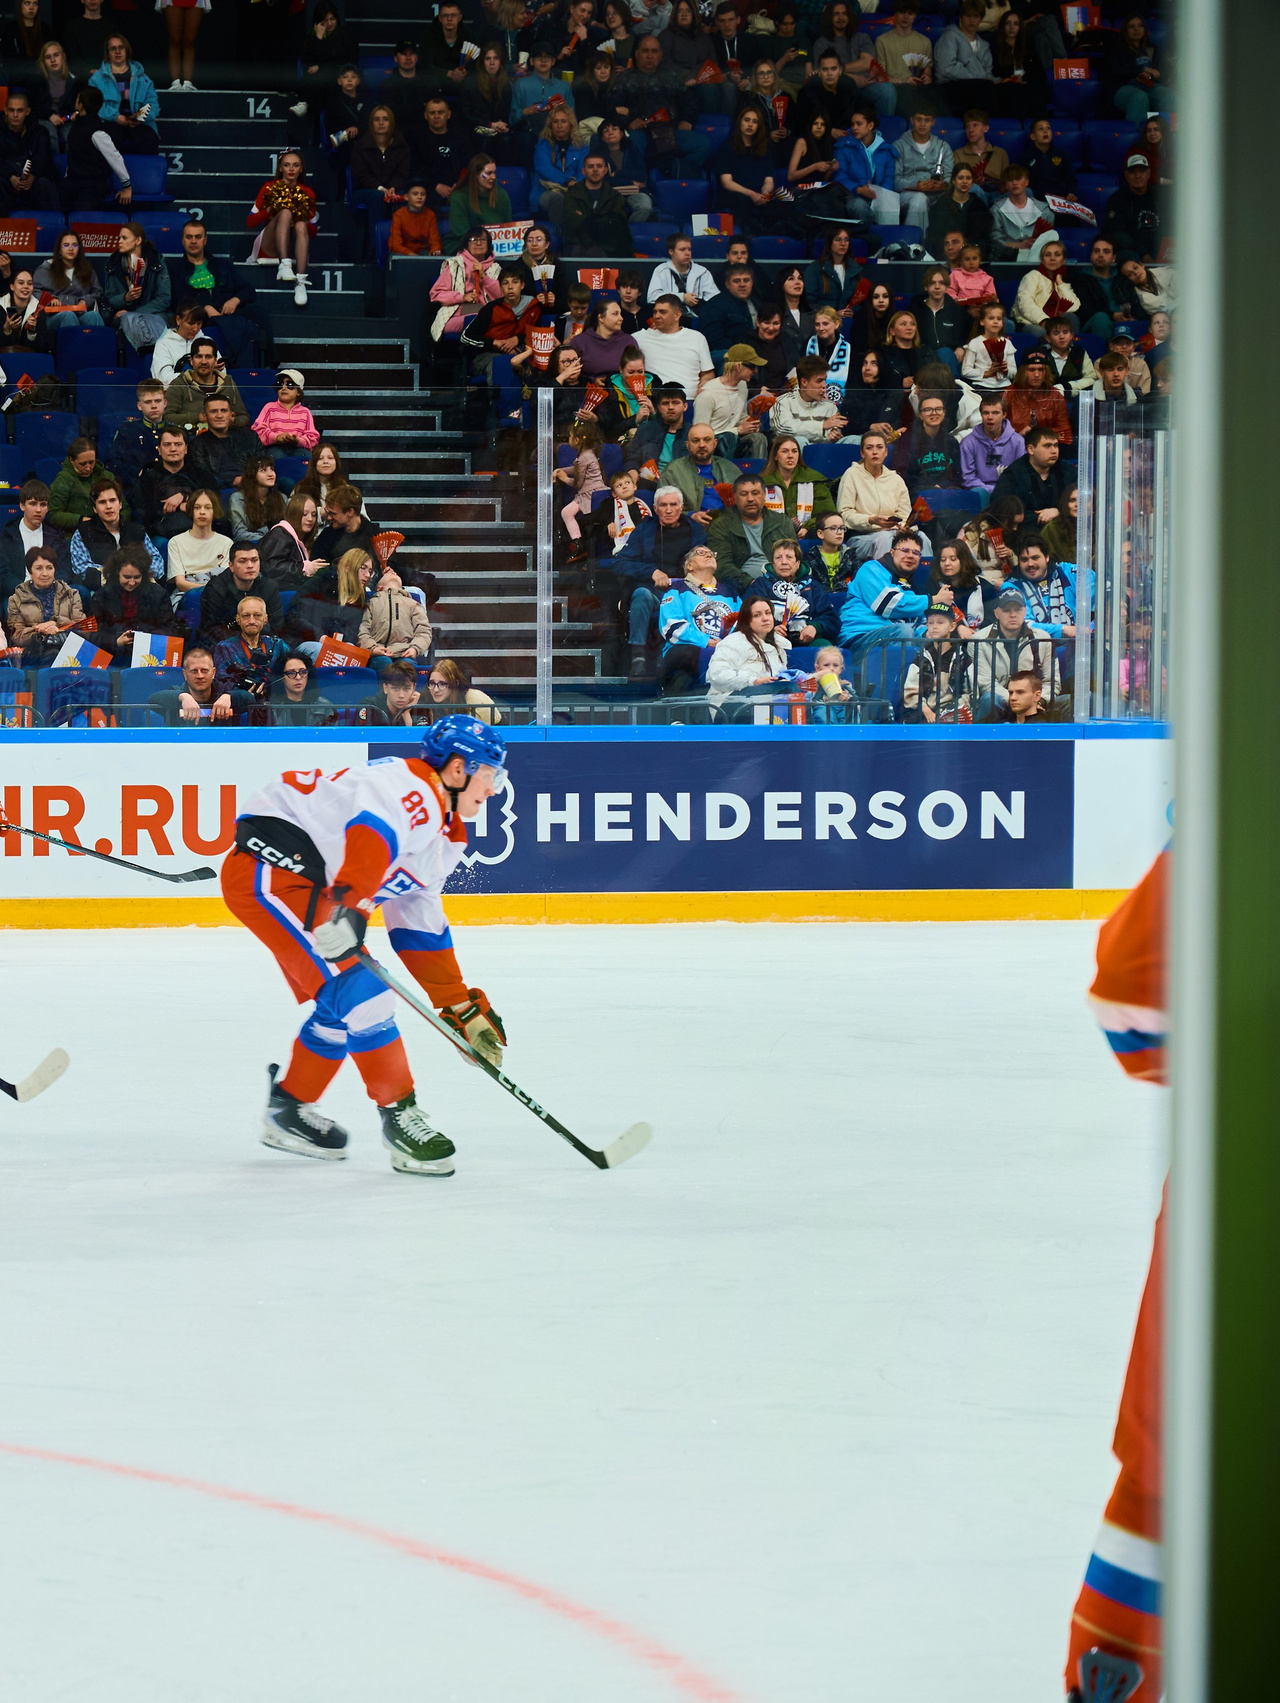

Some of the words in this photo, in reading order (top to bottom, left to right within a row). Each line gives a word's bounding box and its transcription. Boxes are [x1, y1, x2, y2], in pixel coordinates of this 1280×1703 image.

[247, 97, 271, 118] 14
[160, 152, 184, 172] 3
[491, 239, 524, 253] ПЕРЁ
[322, 270, 343, 292] 11
[536, 789, 1026, 842] HENDERSON
[246, 836, 305, 874] CCM
[498, 1071, 548, 1120] CCM
